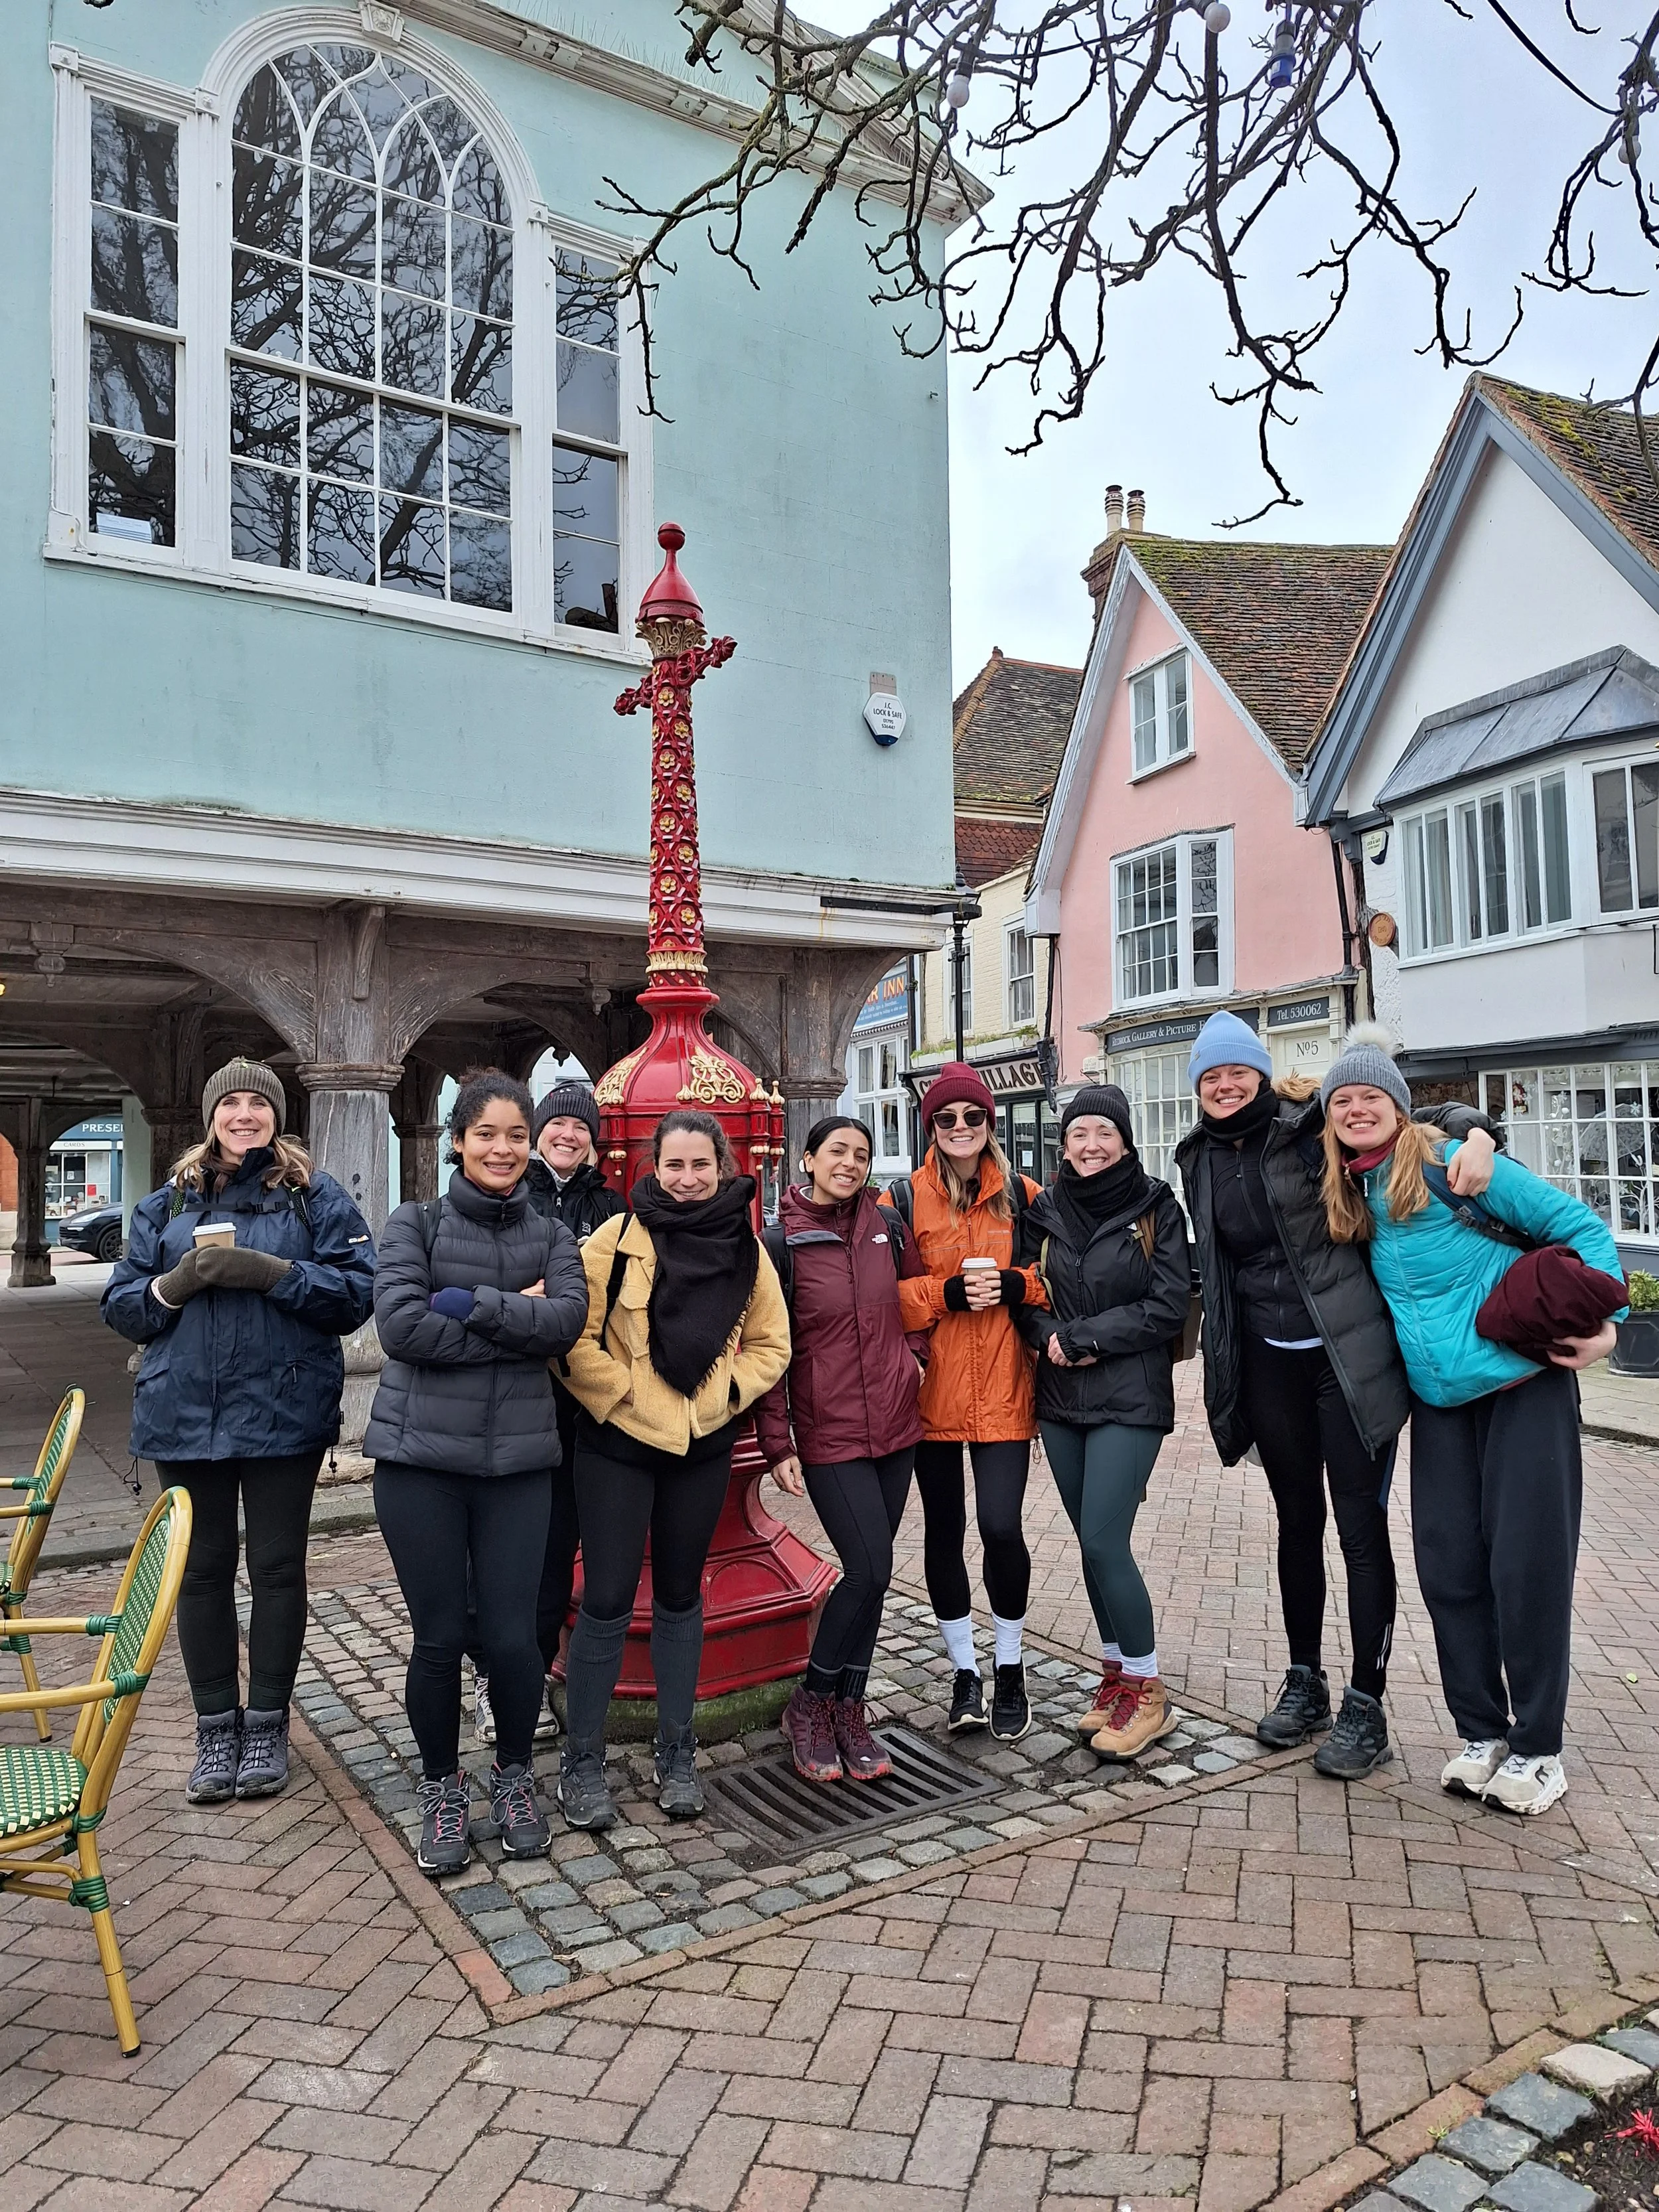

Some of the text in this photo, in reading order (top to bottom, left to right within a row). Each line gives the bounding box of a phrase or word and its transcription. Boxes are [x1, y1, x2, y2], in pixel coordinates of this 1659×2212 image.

[883, 975, 904, 1000] INN
[1290, 1002, 1321, 1019] 530062
[1131, 1029, 1157, 1042] GALLERY
[1158, 1027, 1164, 1037] &
[1165, 1023, 1196, 1035] PICTURE
[977, 1063, 1044, 1090] ILLAG
[82, 1124, 123, 1132] PRESE
